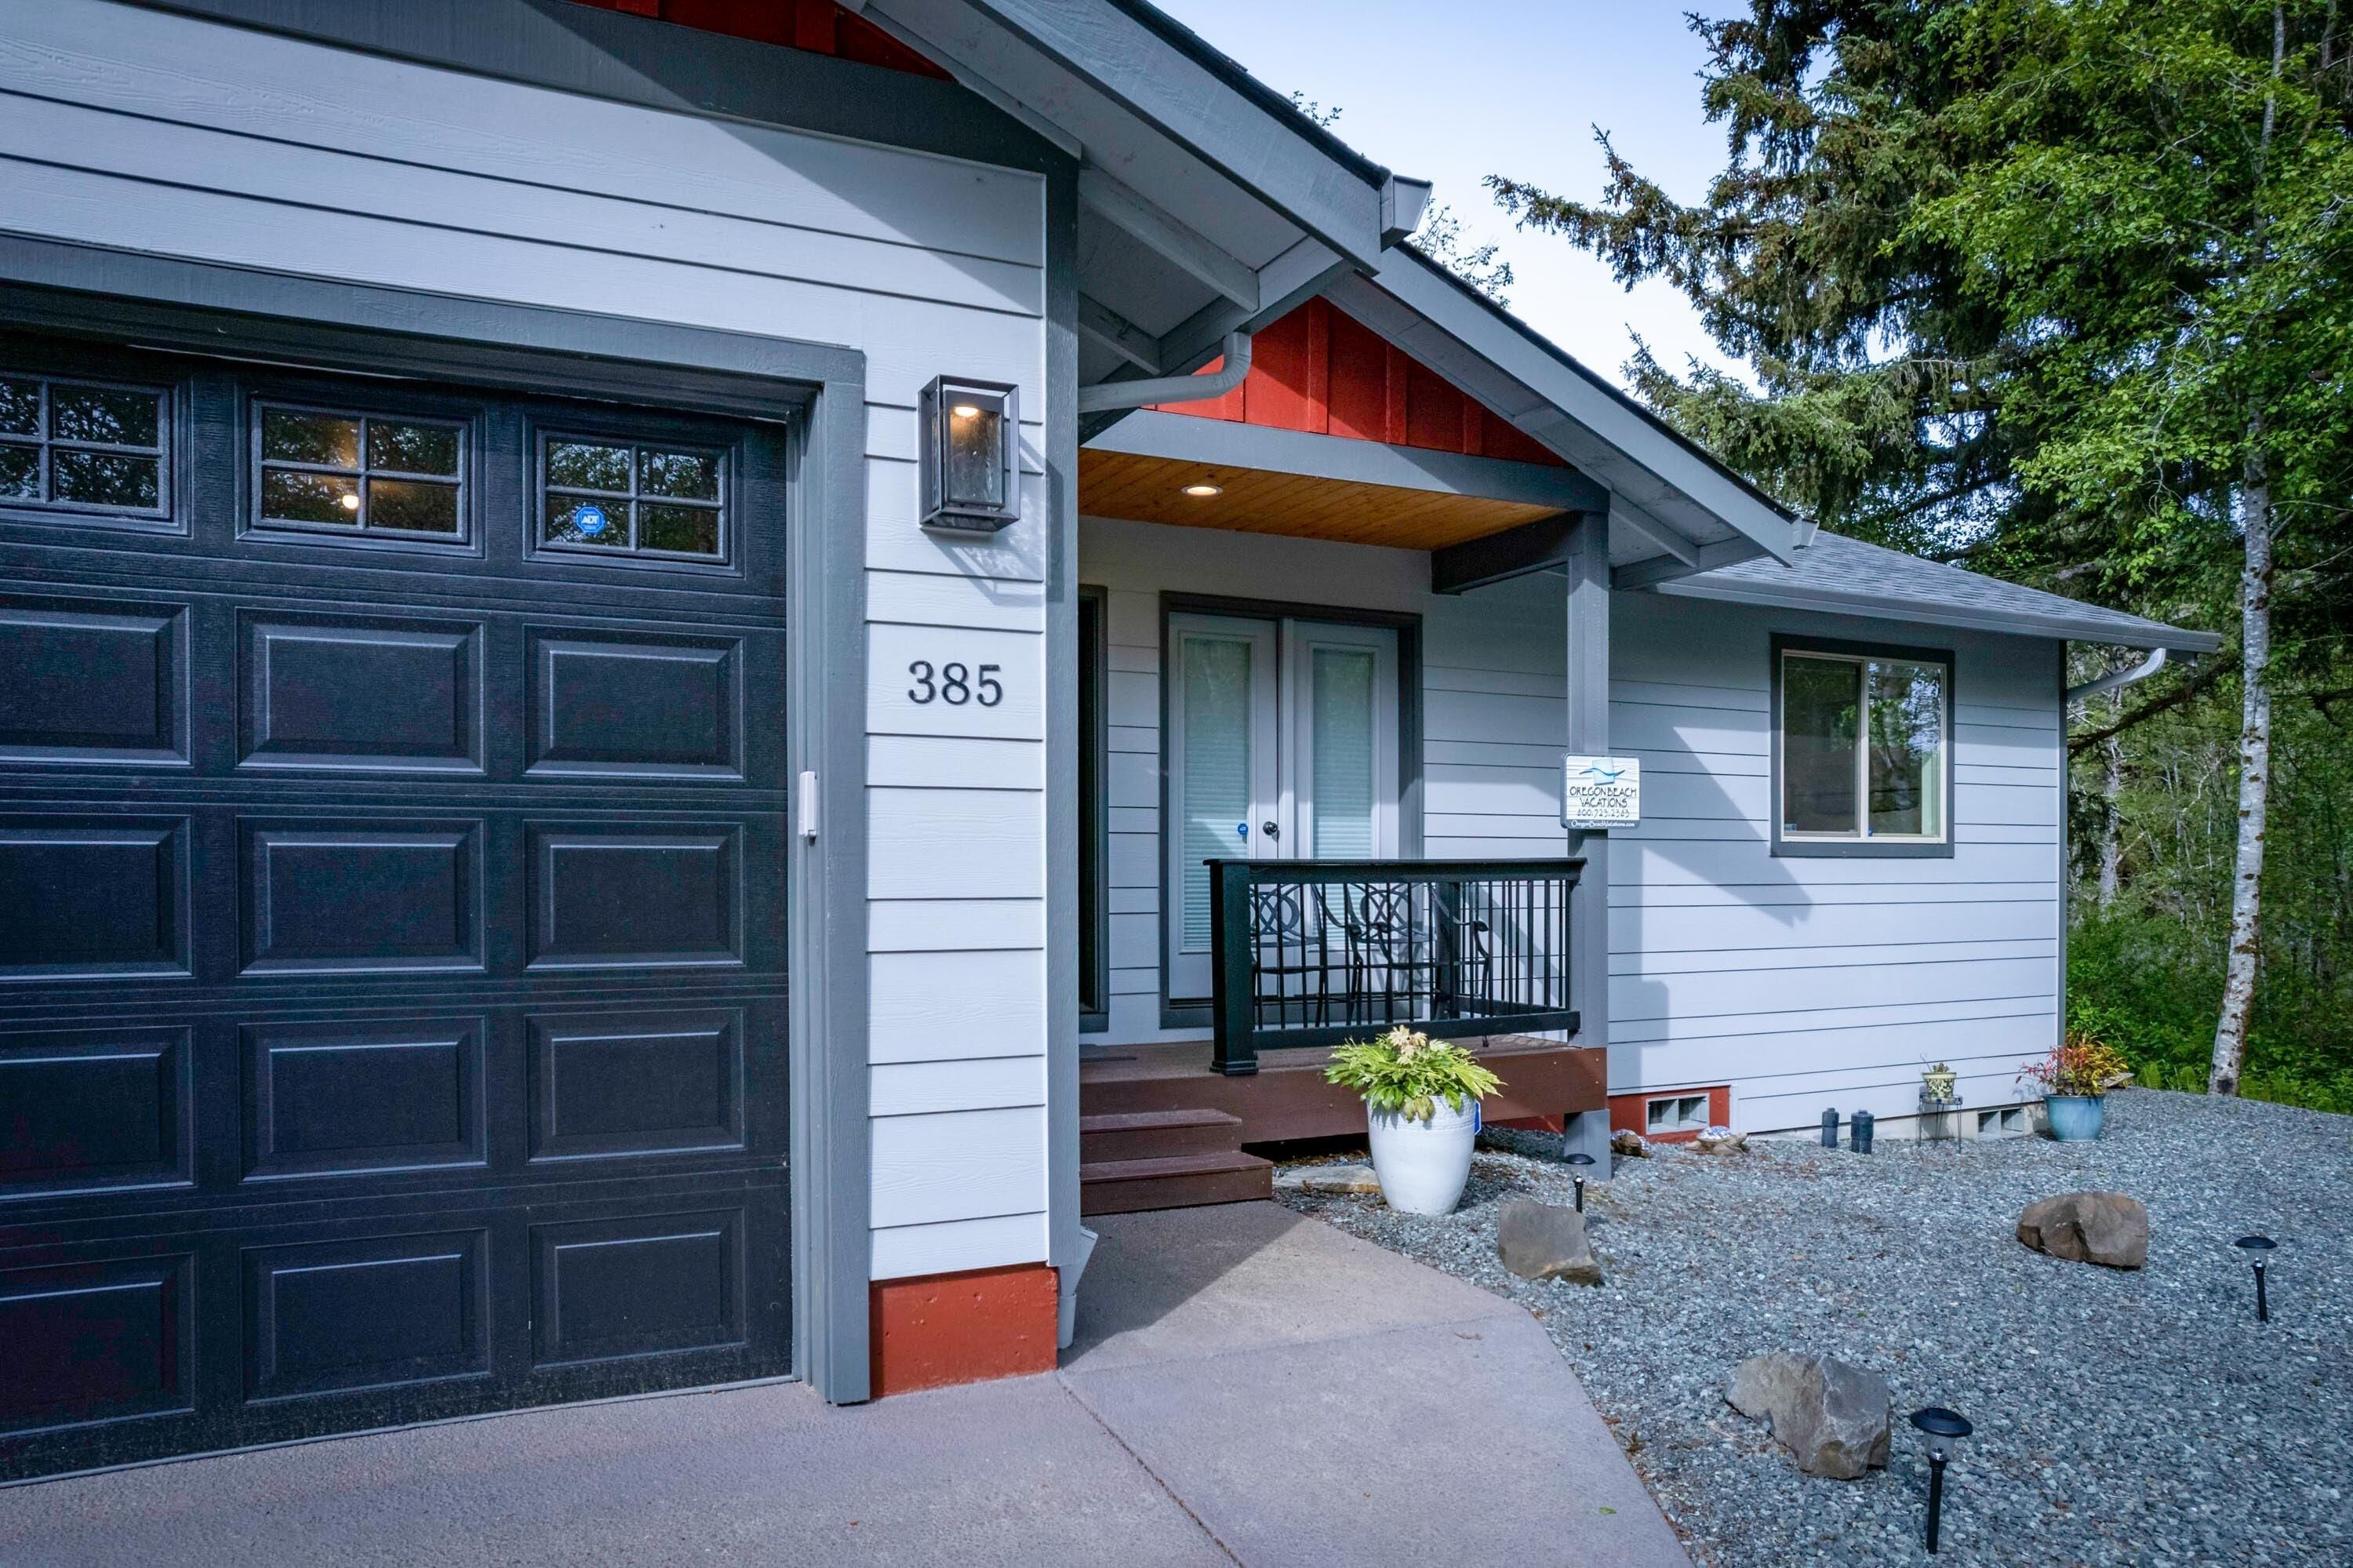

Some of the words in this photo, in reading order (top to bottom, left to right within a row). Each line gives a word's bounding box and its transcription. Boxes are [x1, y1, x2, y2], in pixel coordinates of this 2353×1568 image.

[581, 515, 599, 524] ADT
[908, 660, 1003, 707] 385
[1580, 797, 1627, 807] VACATIONS
